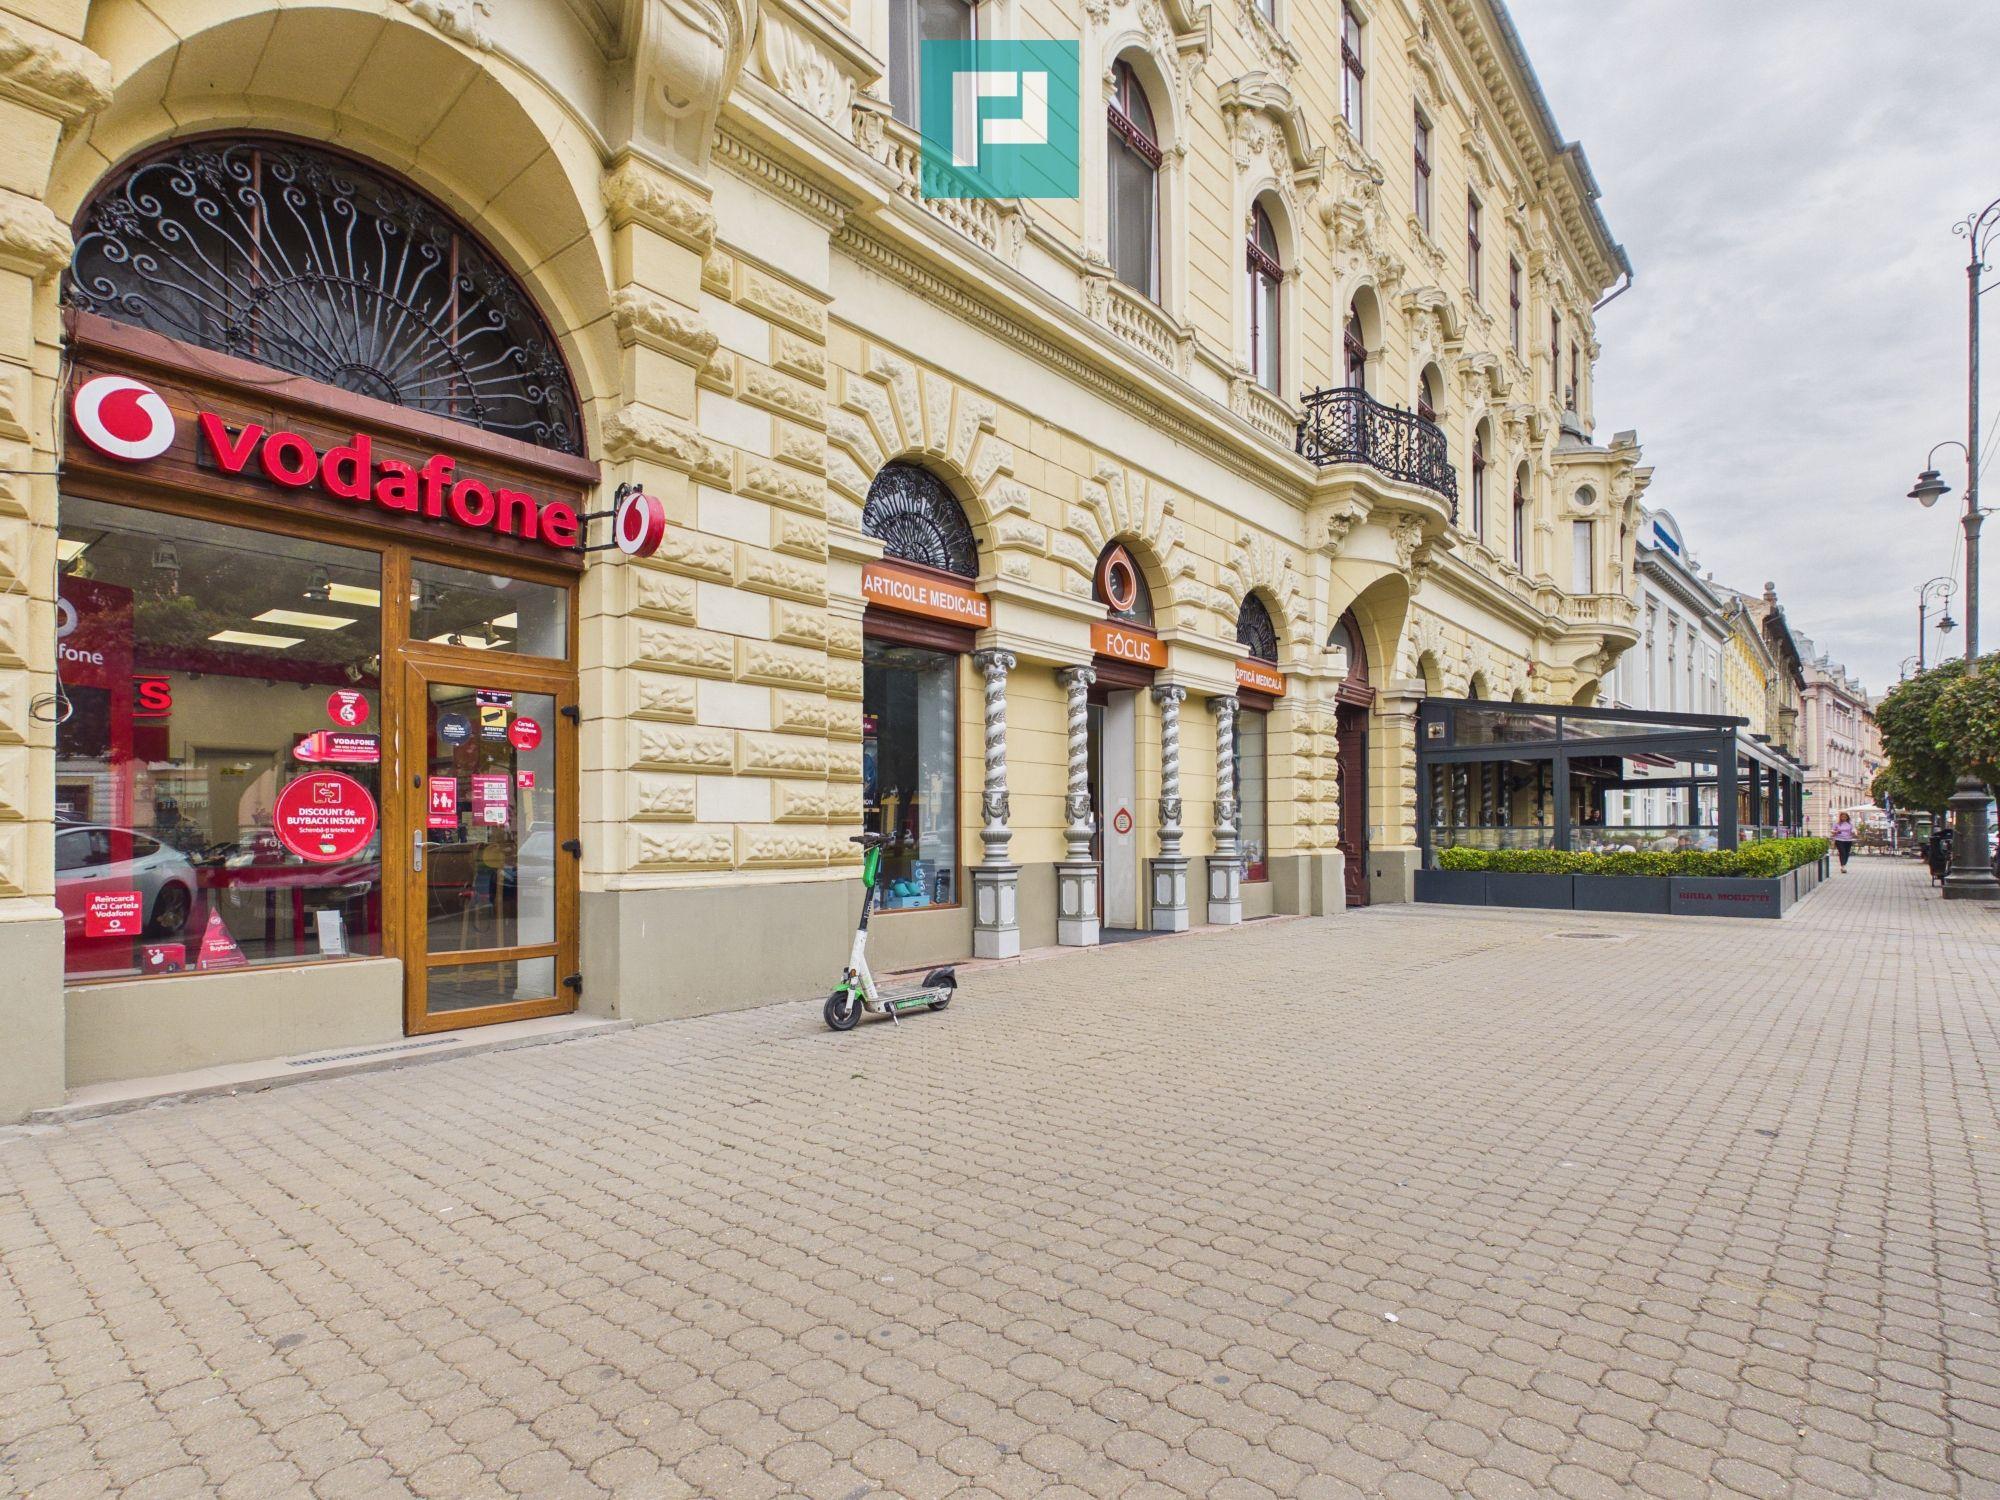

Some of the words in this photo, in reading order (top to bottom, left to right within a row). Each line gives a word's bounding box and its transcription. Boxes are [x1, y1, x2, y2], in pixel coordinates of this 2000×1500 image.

[199, 411, 578, 548] vodafone
[863, 574, 927, 604] ARTICOLE
[930, 590, 987, 618] MEDICALE
[1106, 632, 1150, 662] FOCUS
[333, 738, 375, 746] VODAFONE
[298, 807, 343, 816] DISCOUNT
[344, 808, 356, 816] de
[287, 817, 329, 825] BUYBACK
[330, 817, 366, 825] INSTANT
[91, 903, 108, 911] AICI
[109, 902, 139, 910] Cartela
[95, 910, 134, 918] Vodafone
